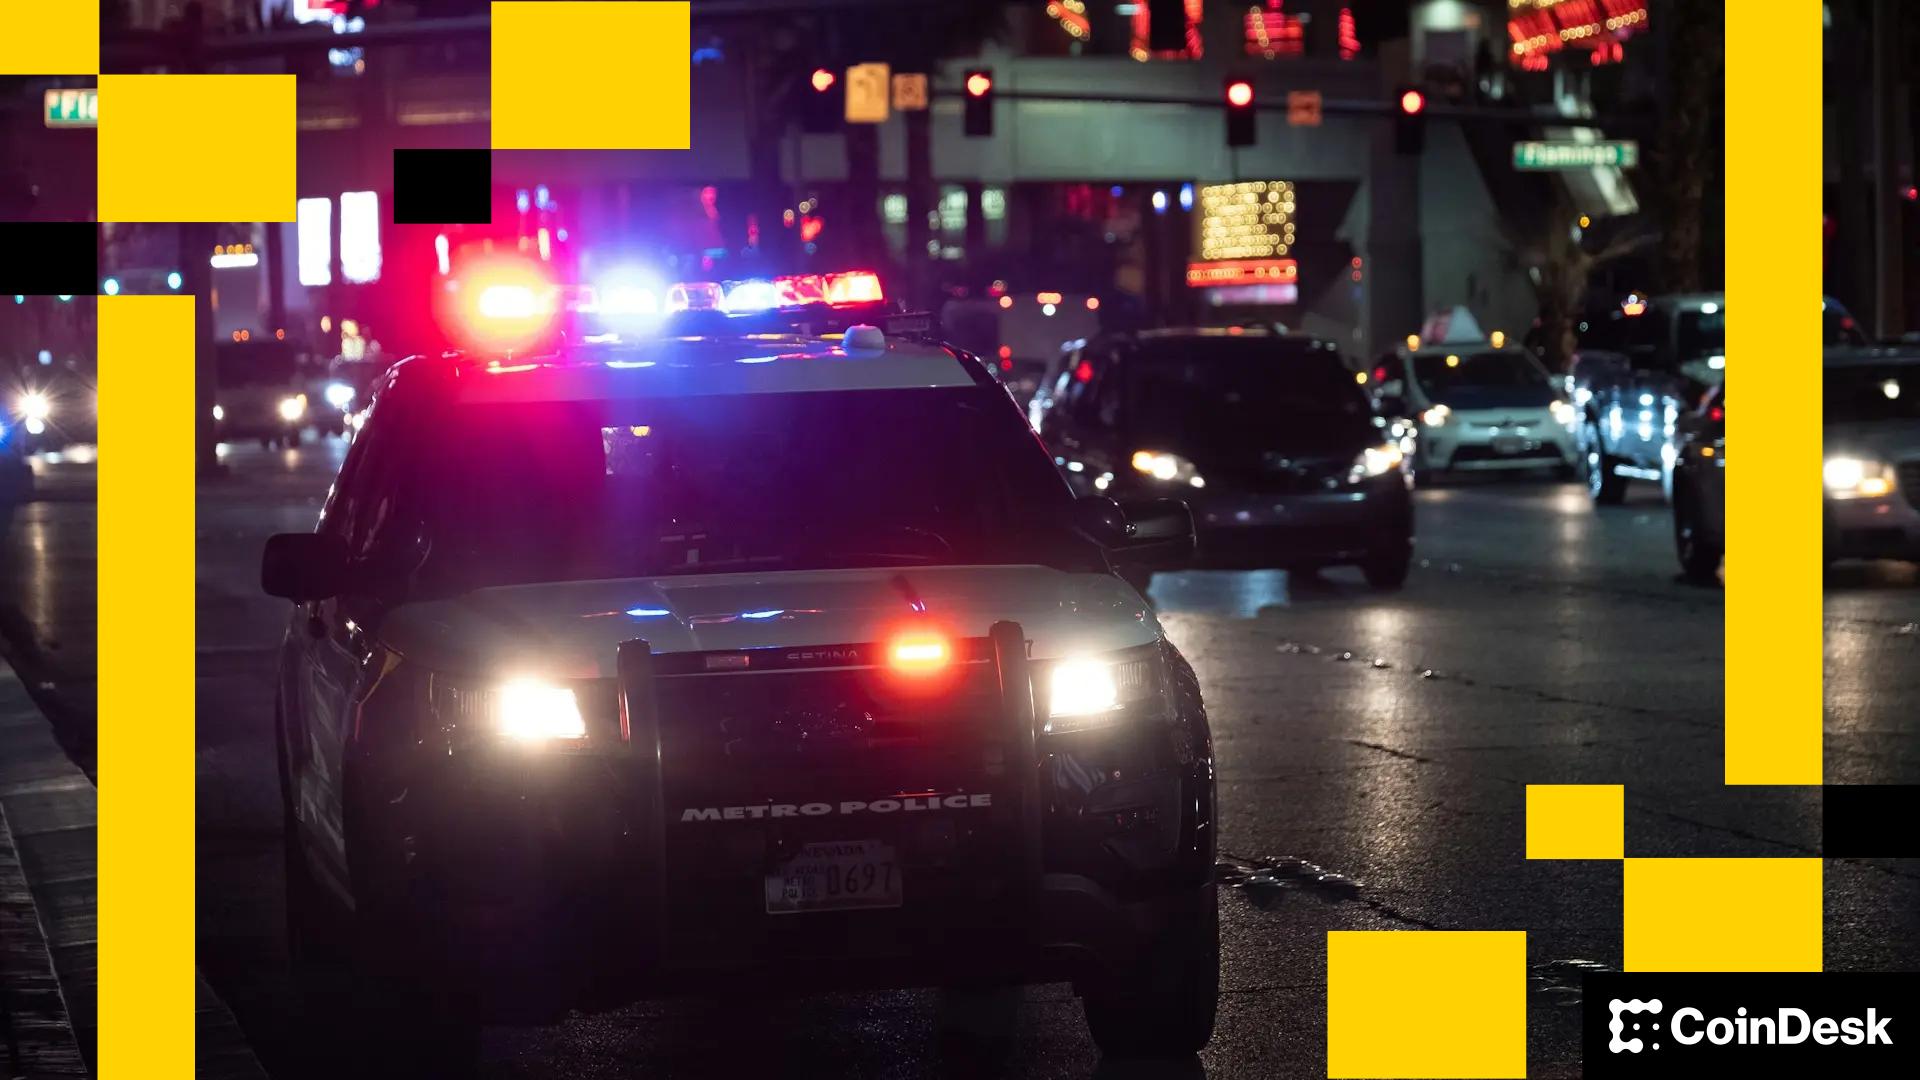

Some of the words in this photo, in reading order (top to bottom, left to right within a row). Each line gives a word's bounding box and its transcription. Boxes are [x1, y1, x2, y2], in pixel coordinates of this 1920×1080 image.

[1523, 143, 1617, 166] Flamingo
[681, 802, 833, 822] METRO
[839, 793, 992, 815] POLICE
[826, 862, 894, 896] 0697
